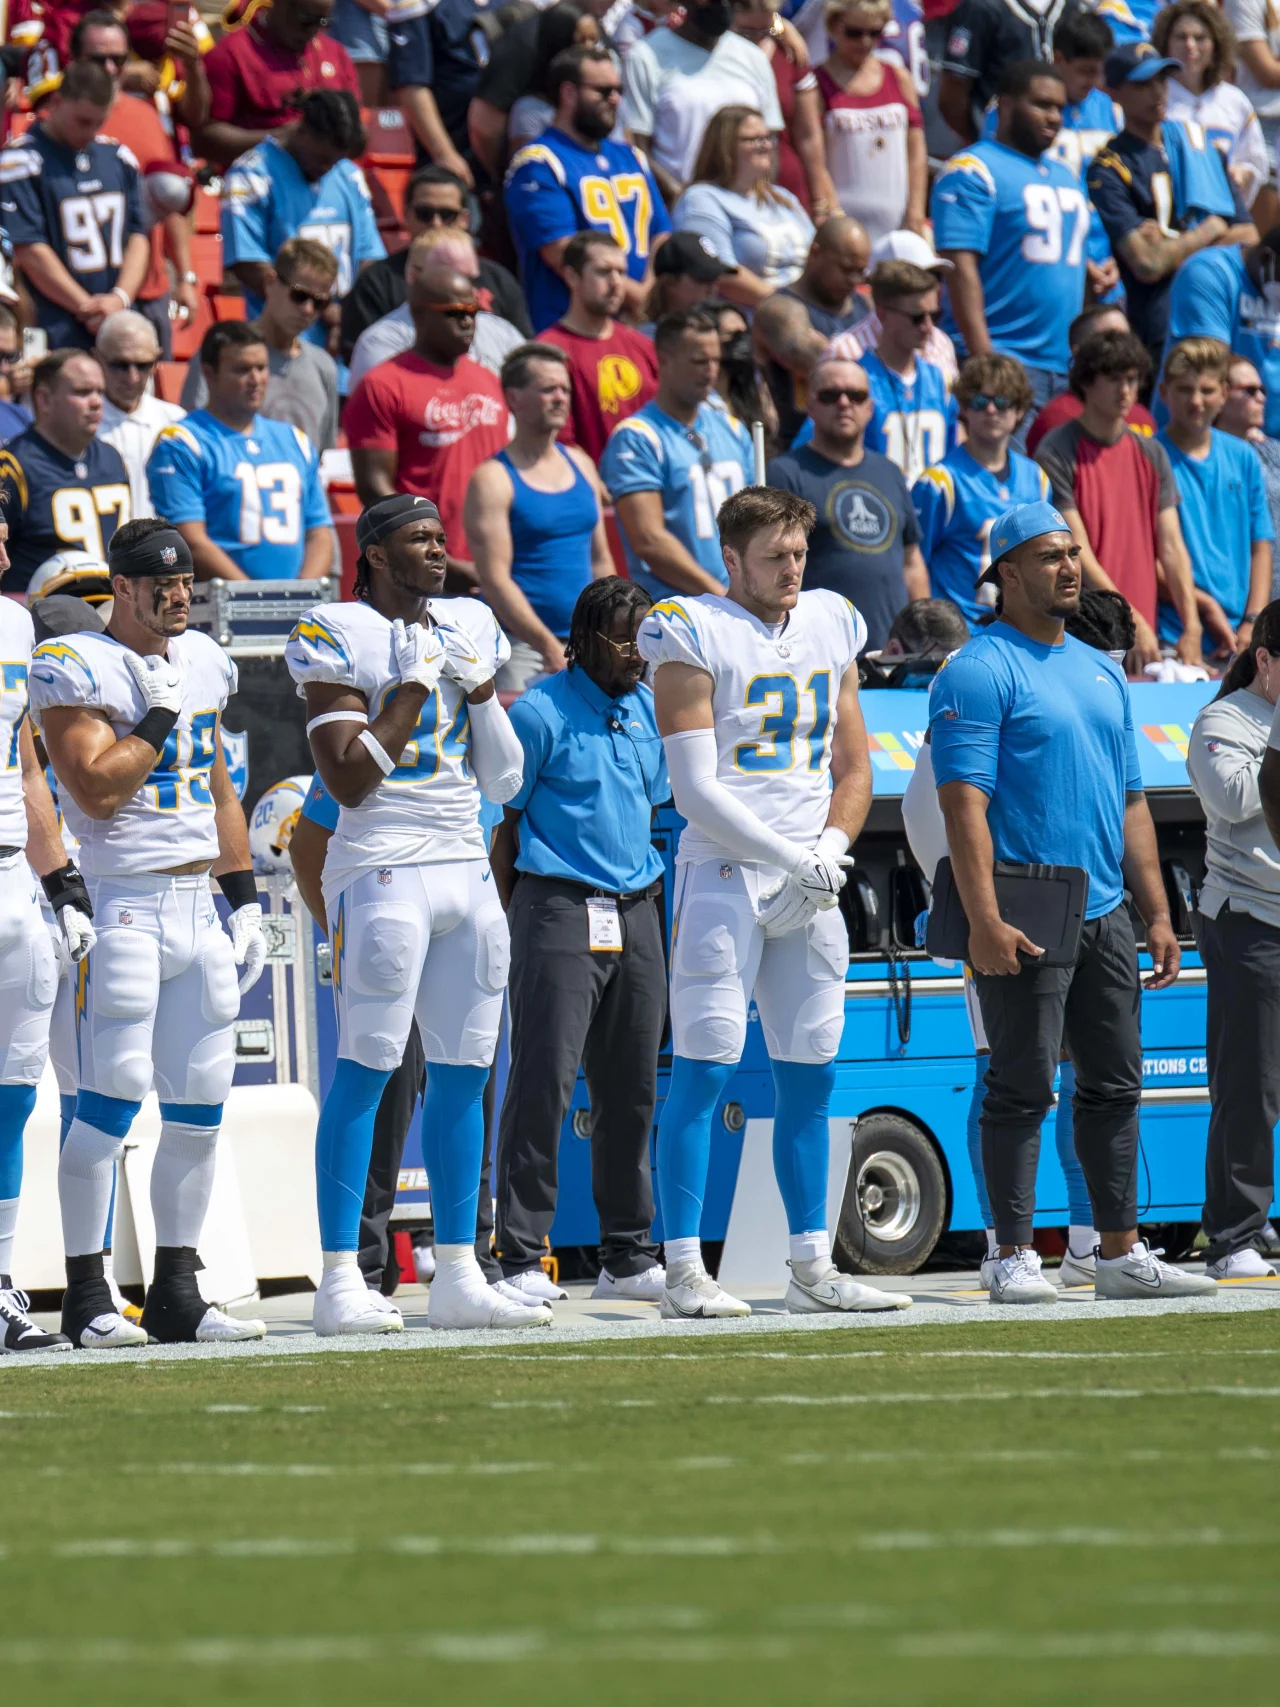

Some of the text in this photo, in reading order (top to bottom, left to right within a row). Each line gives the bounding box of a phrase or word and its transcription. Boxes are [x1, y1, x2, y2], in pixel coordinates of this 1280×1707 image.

[60, 191, 126, 274] 97
[580, 173, 644, 258] 97
[1021, 183, 1090, 267] 97
[883, 410, 944, 493] 10
[52, 483, 132, 562] 97
[235, 461, 302, 545] 13
[848, 519, 881, 535] ATARI
[735, 670, 831, 774] 31
